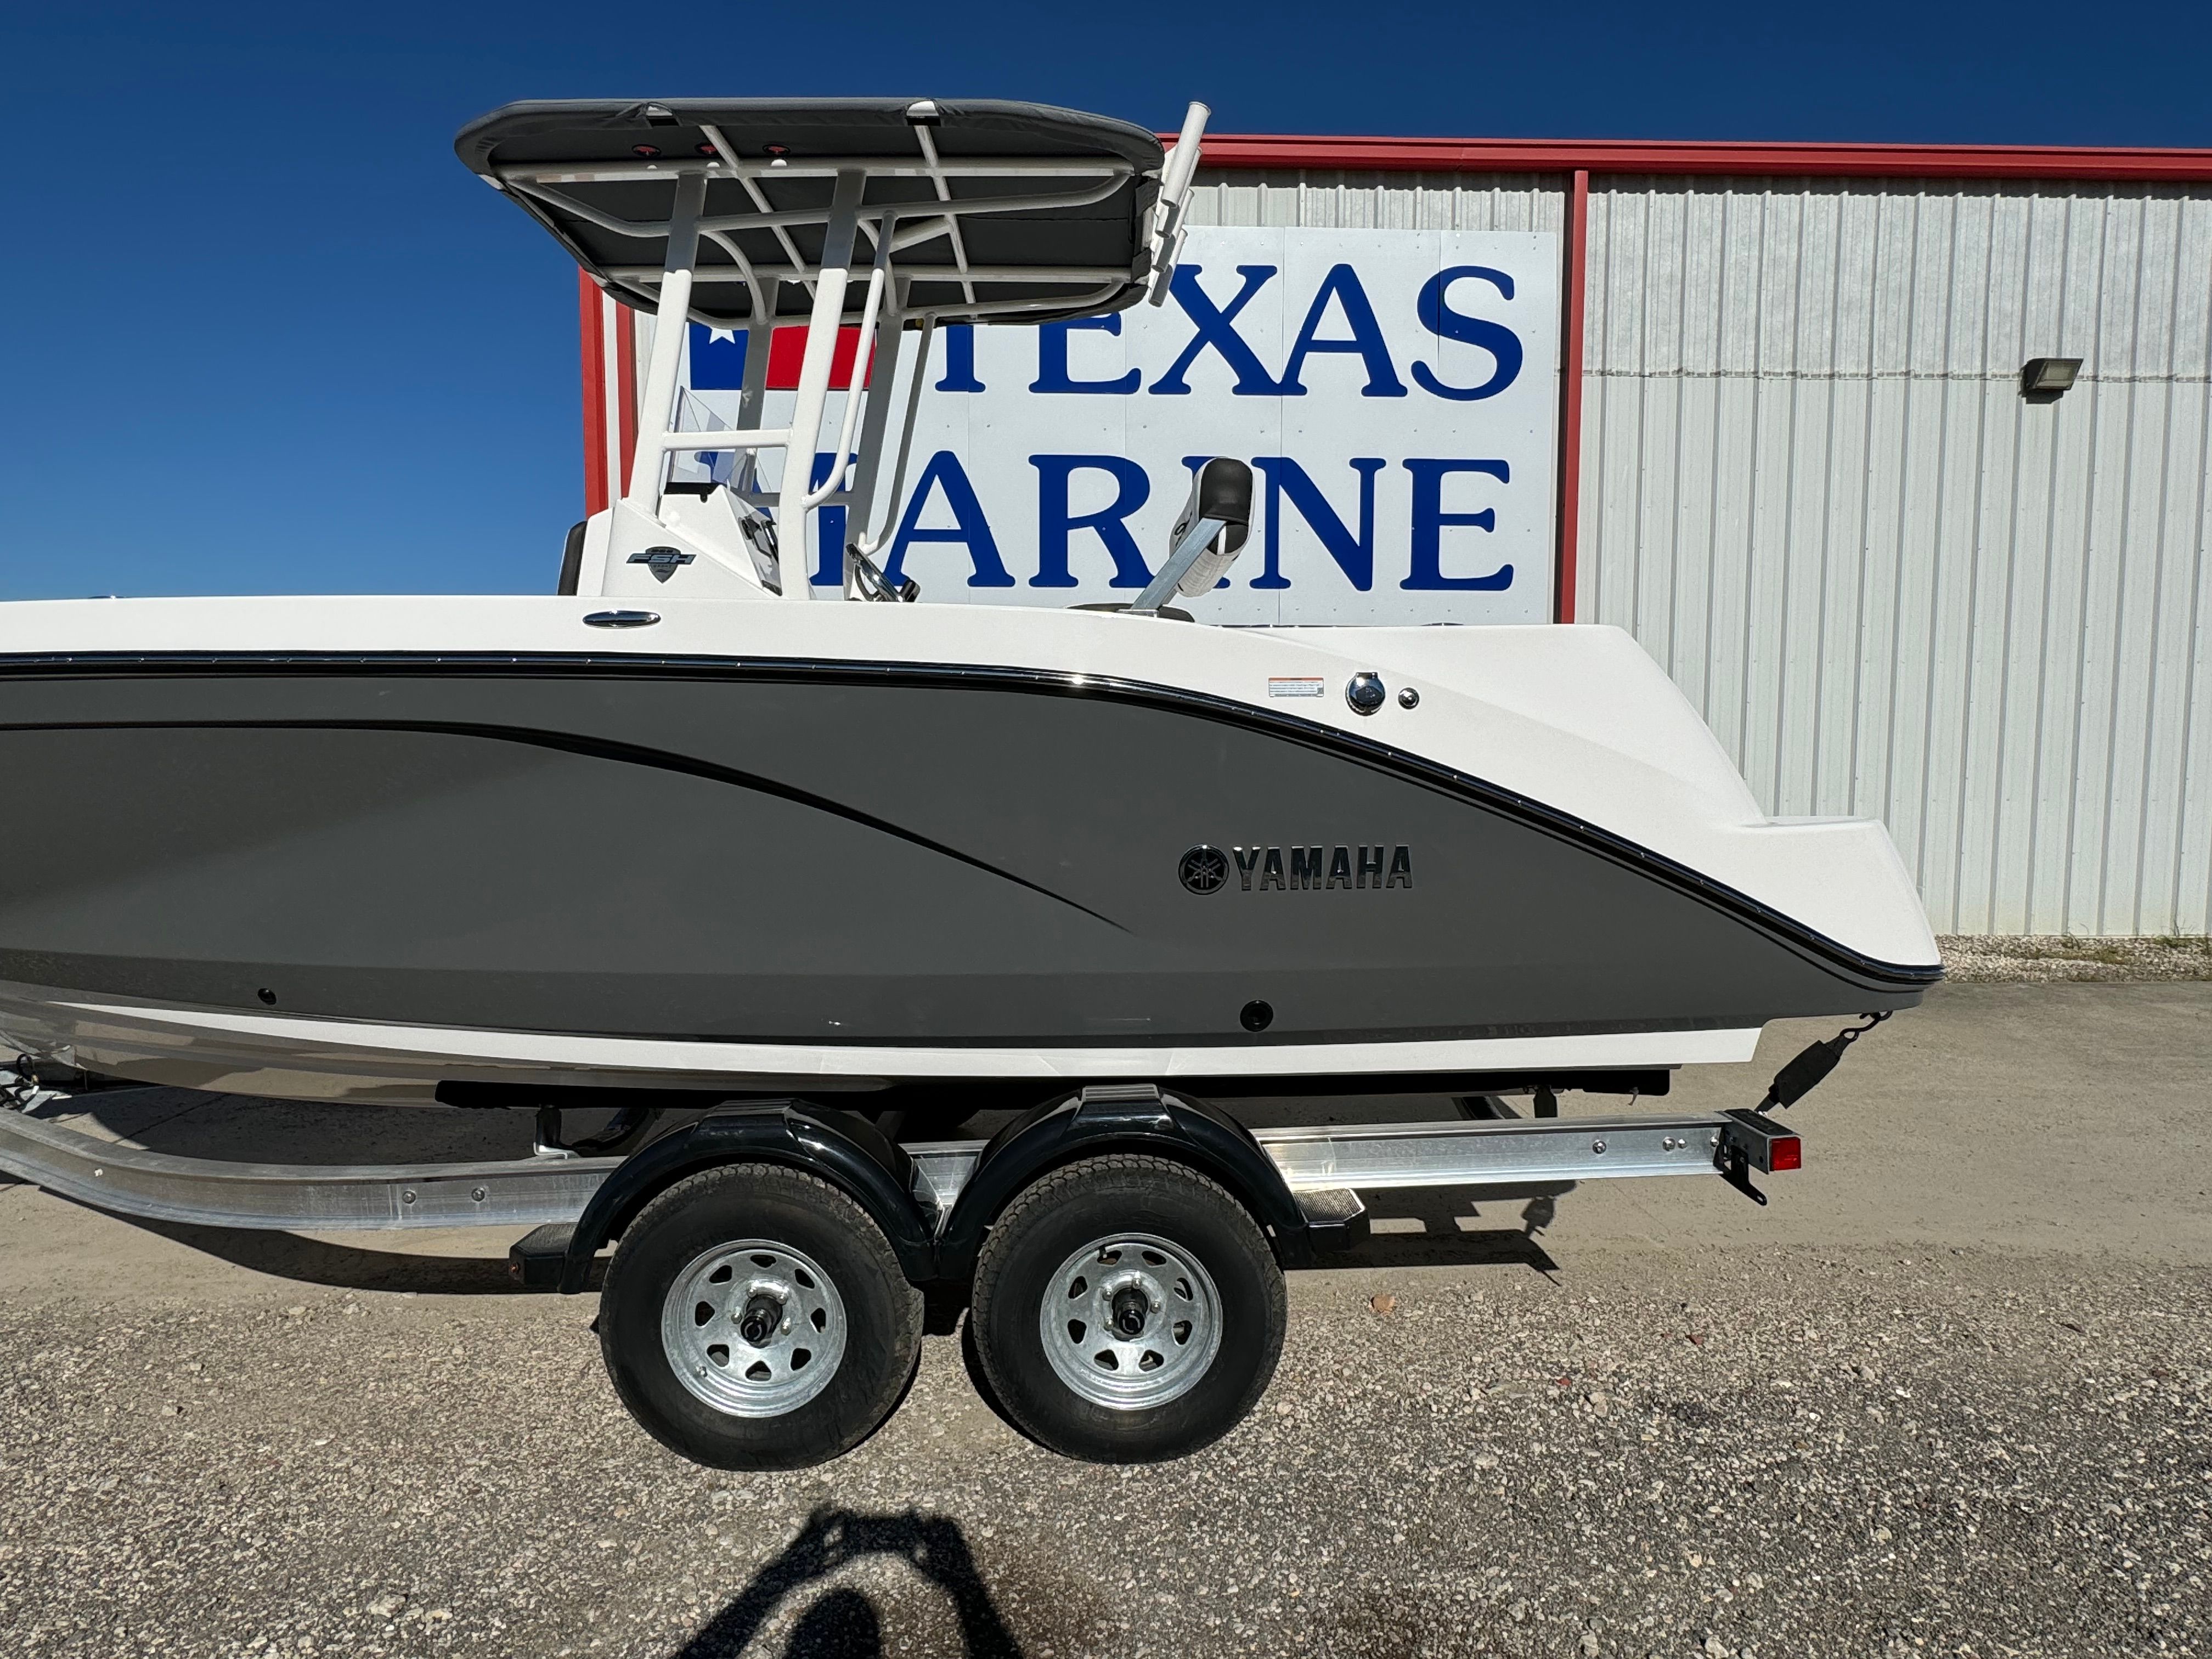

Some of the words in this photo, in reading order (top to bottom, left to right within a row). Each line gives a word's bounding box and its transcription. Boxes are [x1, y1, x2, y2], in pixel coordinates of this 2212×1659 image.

[694, 450, 1514, 591] ARNE
[628, 554, 696, 563] FSH
[1232, 844, 1413, 891] YAMAHA
